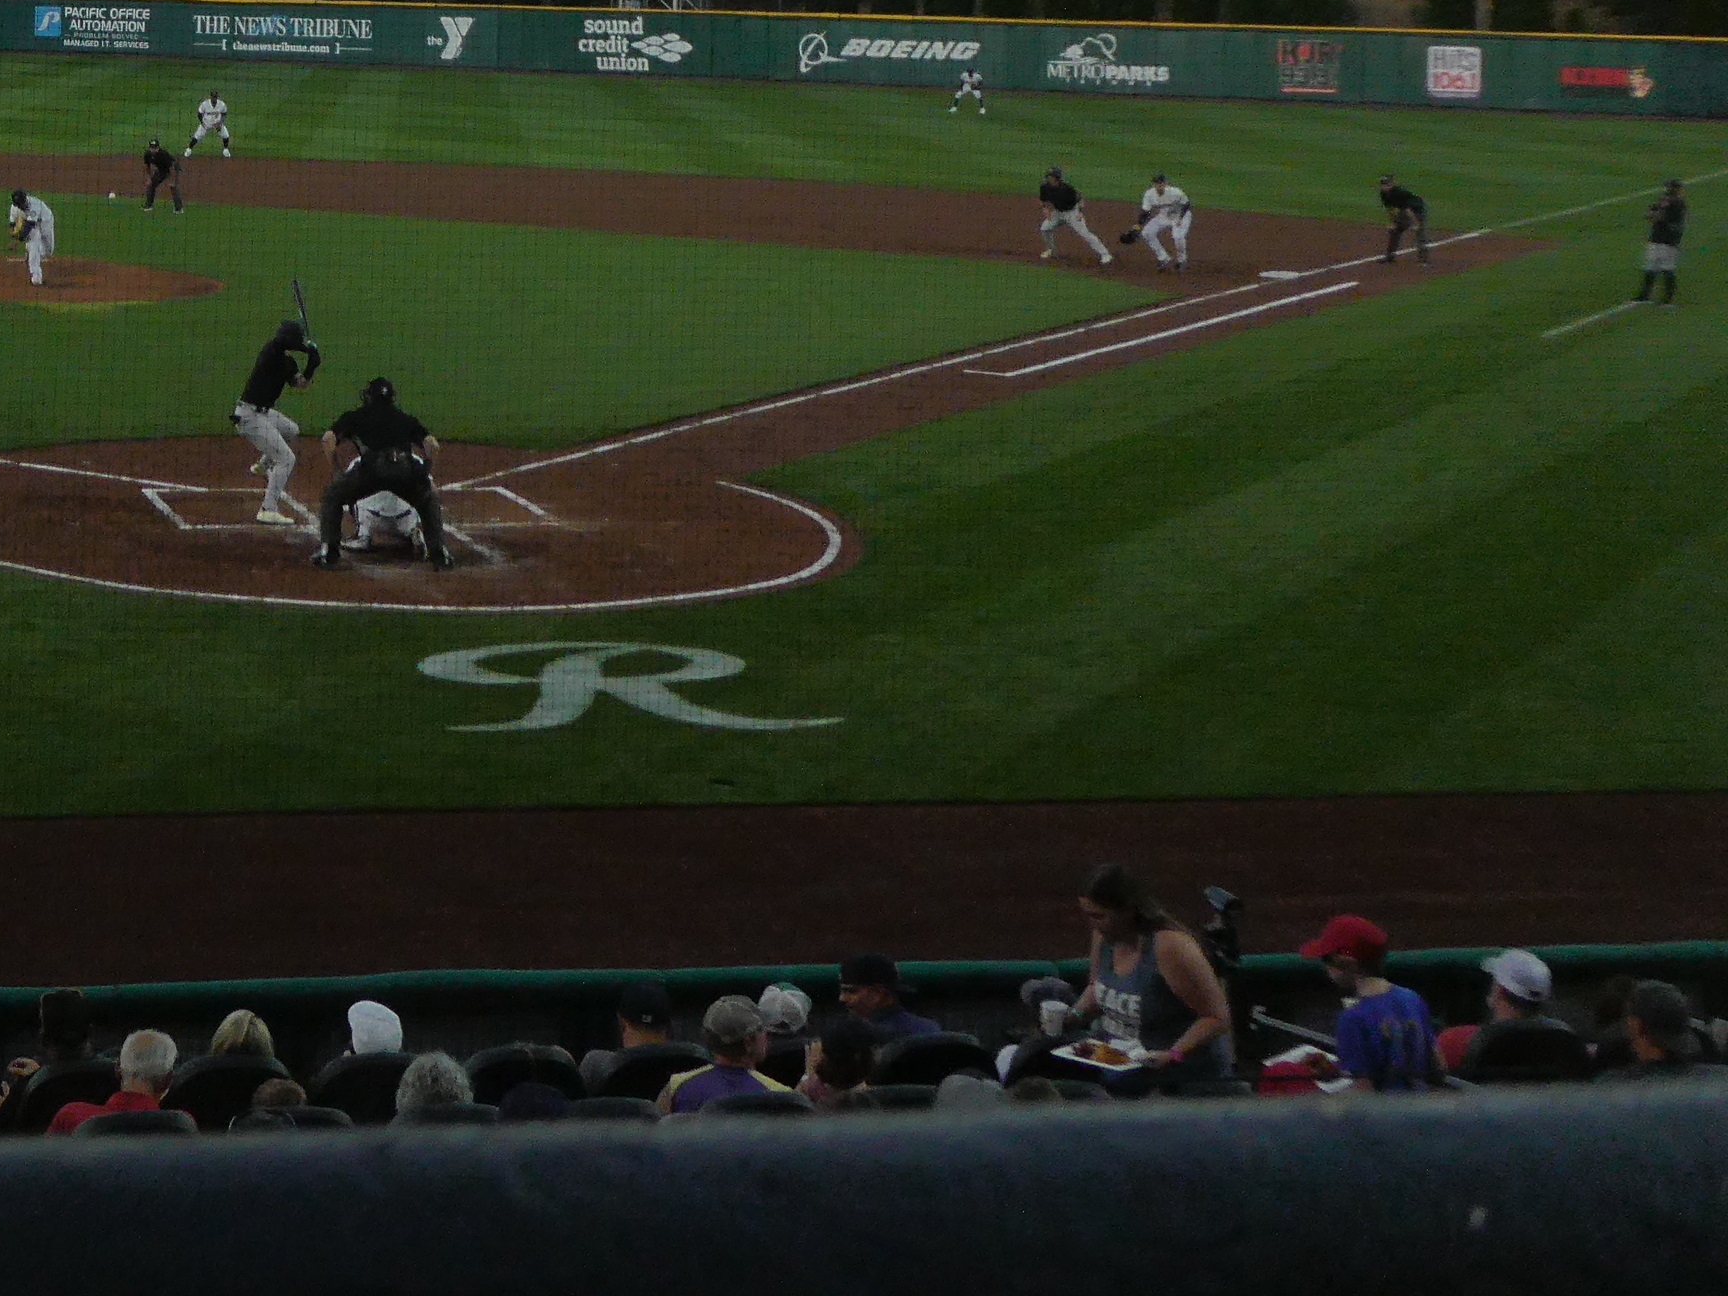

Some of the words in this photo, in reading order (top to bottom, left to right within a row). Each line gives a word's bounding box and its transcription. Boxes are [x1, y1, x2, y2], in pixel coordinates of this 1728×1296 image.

[64, 6, 106, 19] PACIFIC
[110, 8, 151, 20] OFFICE
[69, 19, 146, 32] AUTOMATION
[192, 15, 230, 35] THE
[234, 16, 286, 37] NEWS
[290, 18, 372, 40] TRIBUNE
[584, 16, 644, 35] sound
[64, 39, 99, 47] MANAGED
[114, 40, 149, 49] SERVICES
[232, 41, 330, 54] thenewstribune.com
[426, 35, 443, 47] the
[578, 34, 630, 54] credit
[840, 38, 981, 60] BOEING
[596, 54, 650, 72] union
